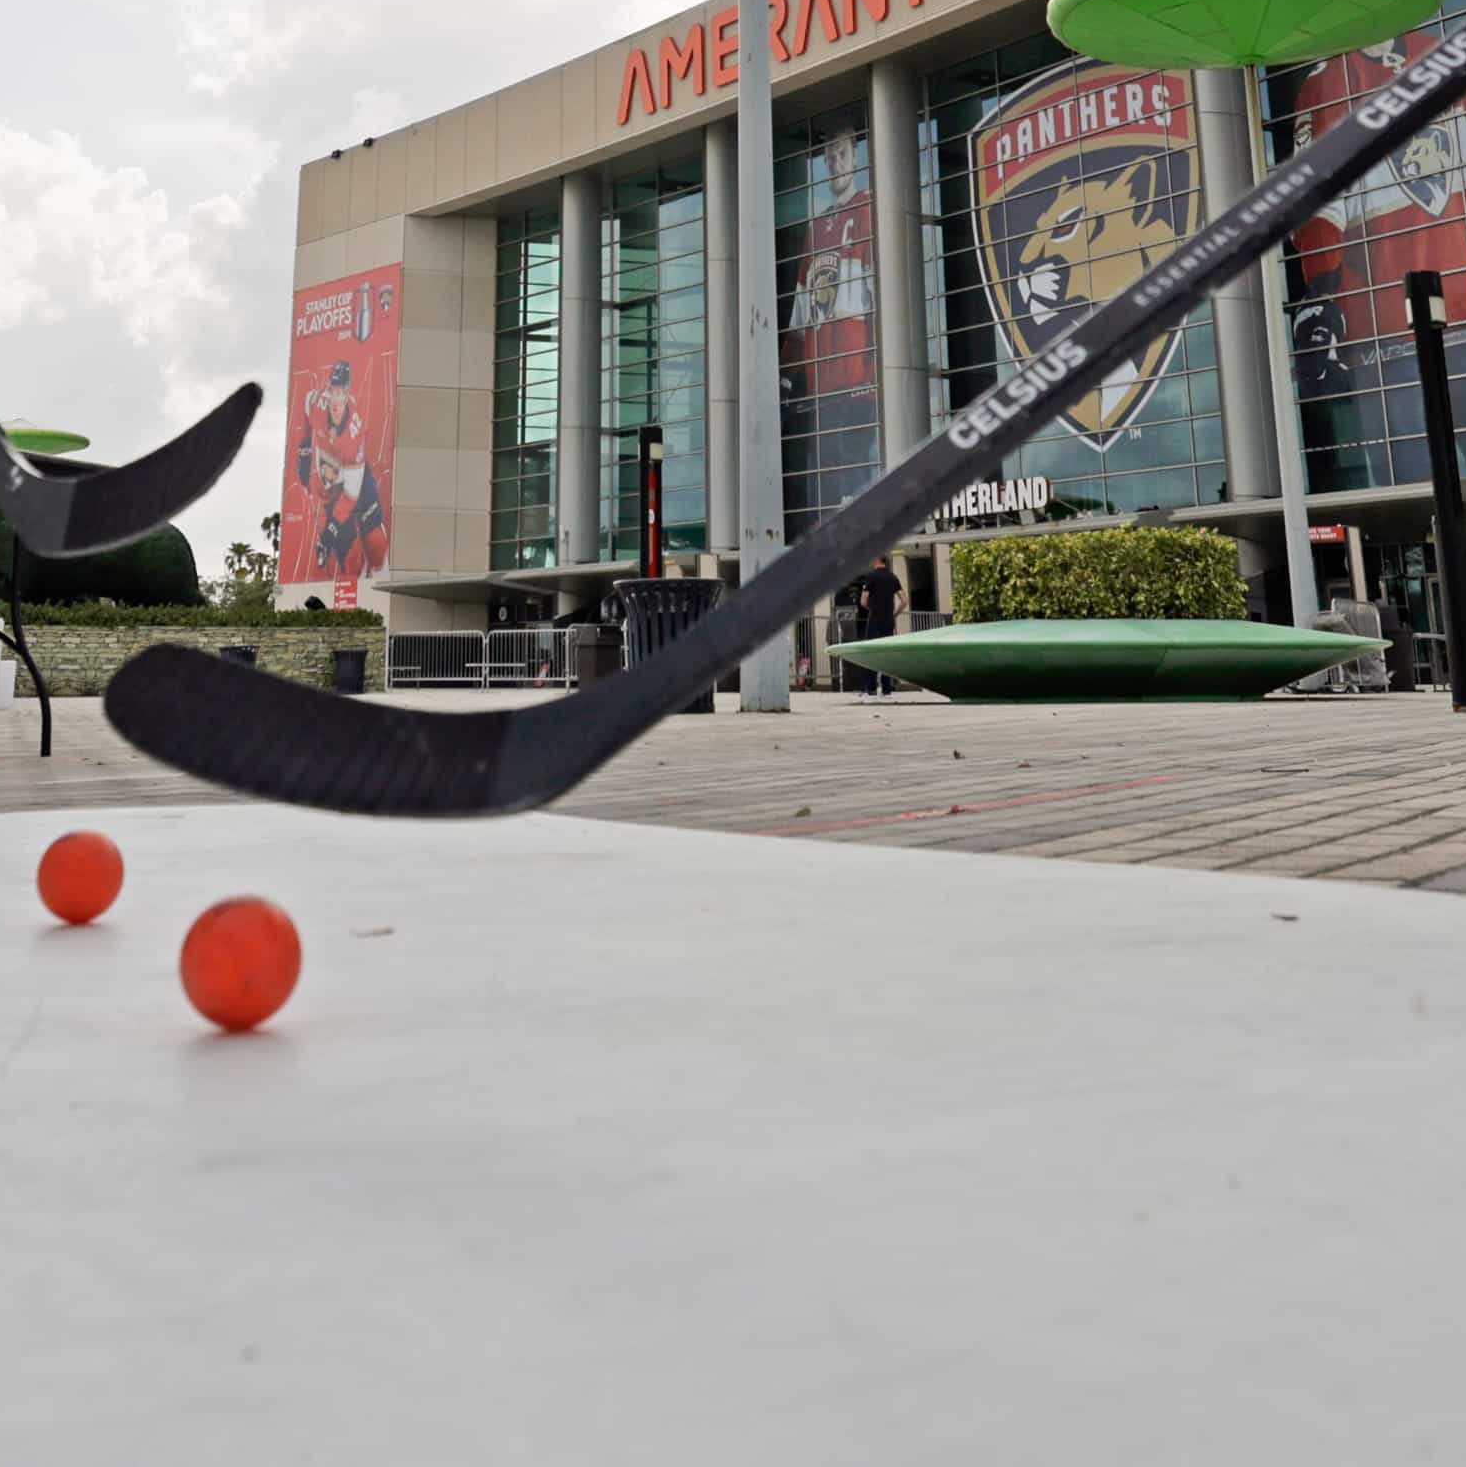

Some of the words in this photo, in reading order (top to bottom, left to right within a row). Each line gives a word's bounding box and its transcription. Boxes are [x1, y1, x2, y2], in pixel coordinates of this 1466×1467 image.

[996, 83, 1172, 180] PANTHERS
[1133, 225, 1240, 308] ESSENTIAL
[296, 305, 352, 338] PLAYOFFS
[947, 339, 1088, 450] CELSIUS
